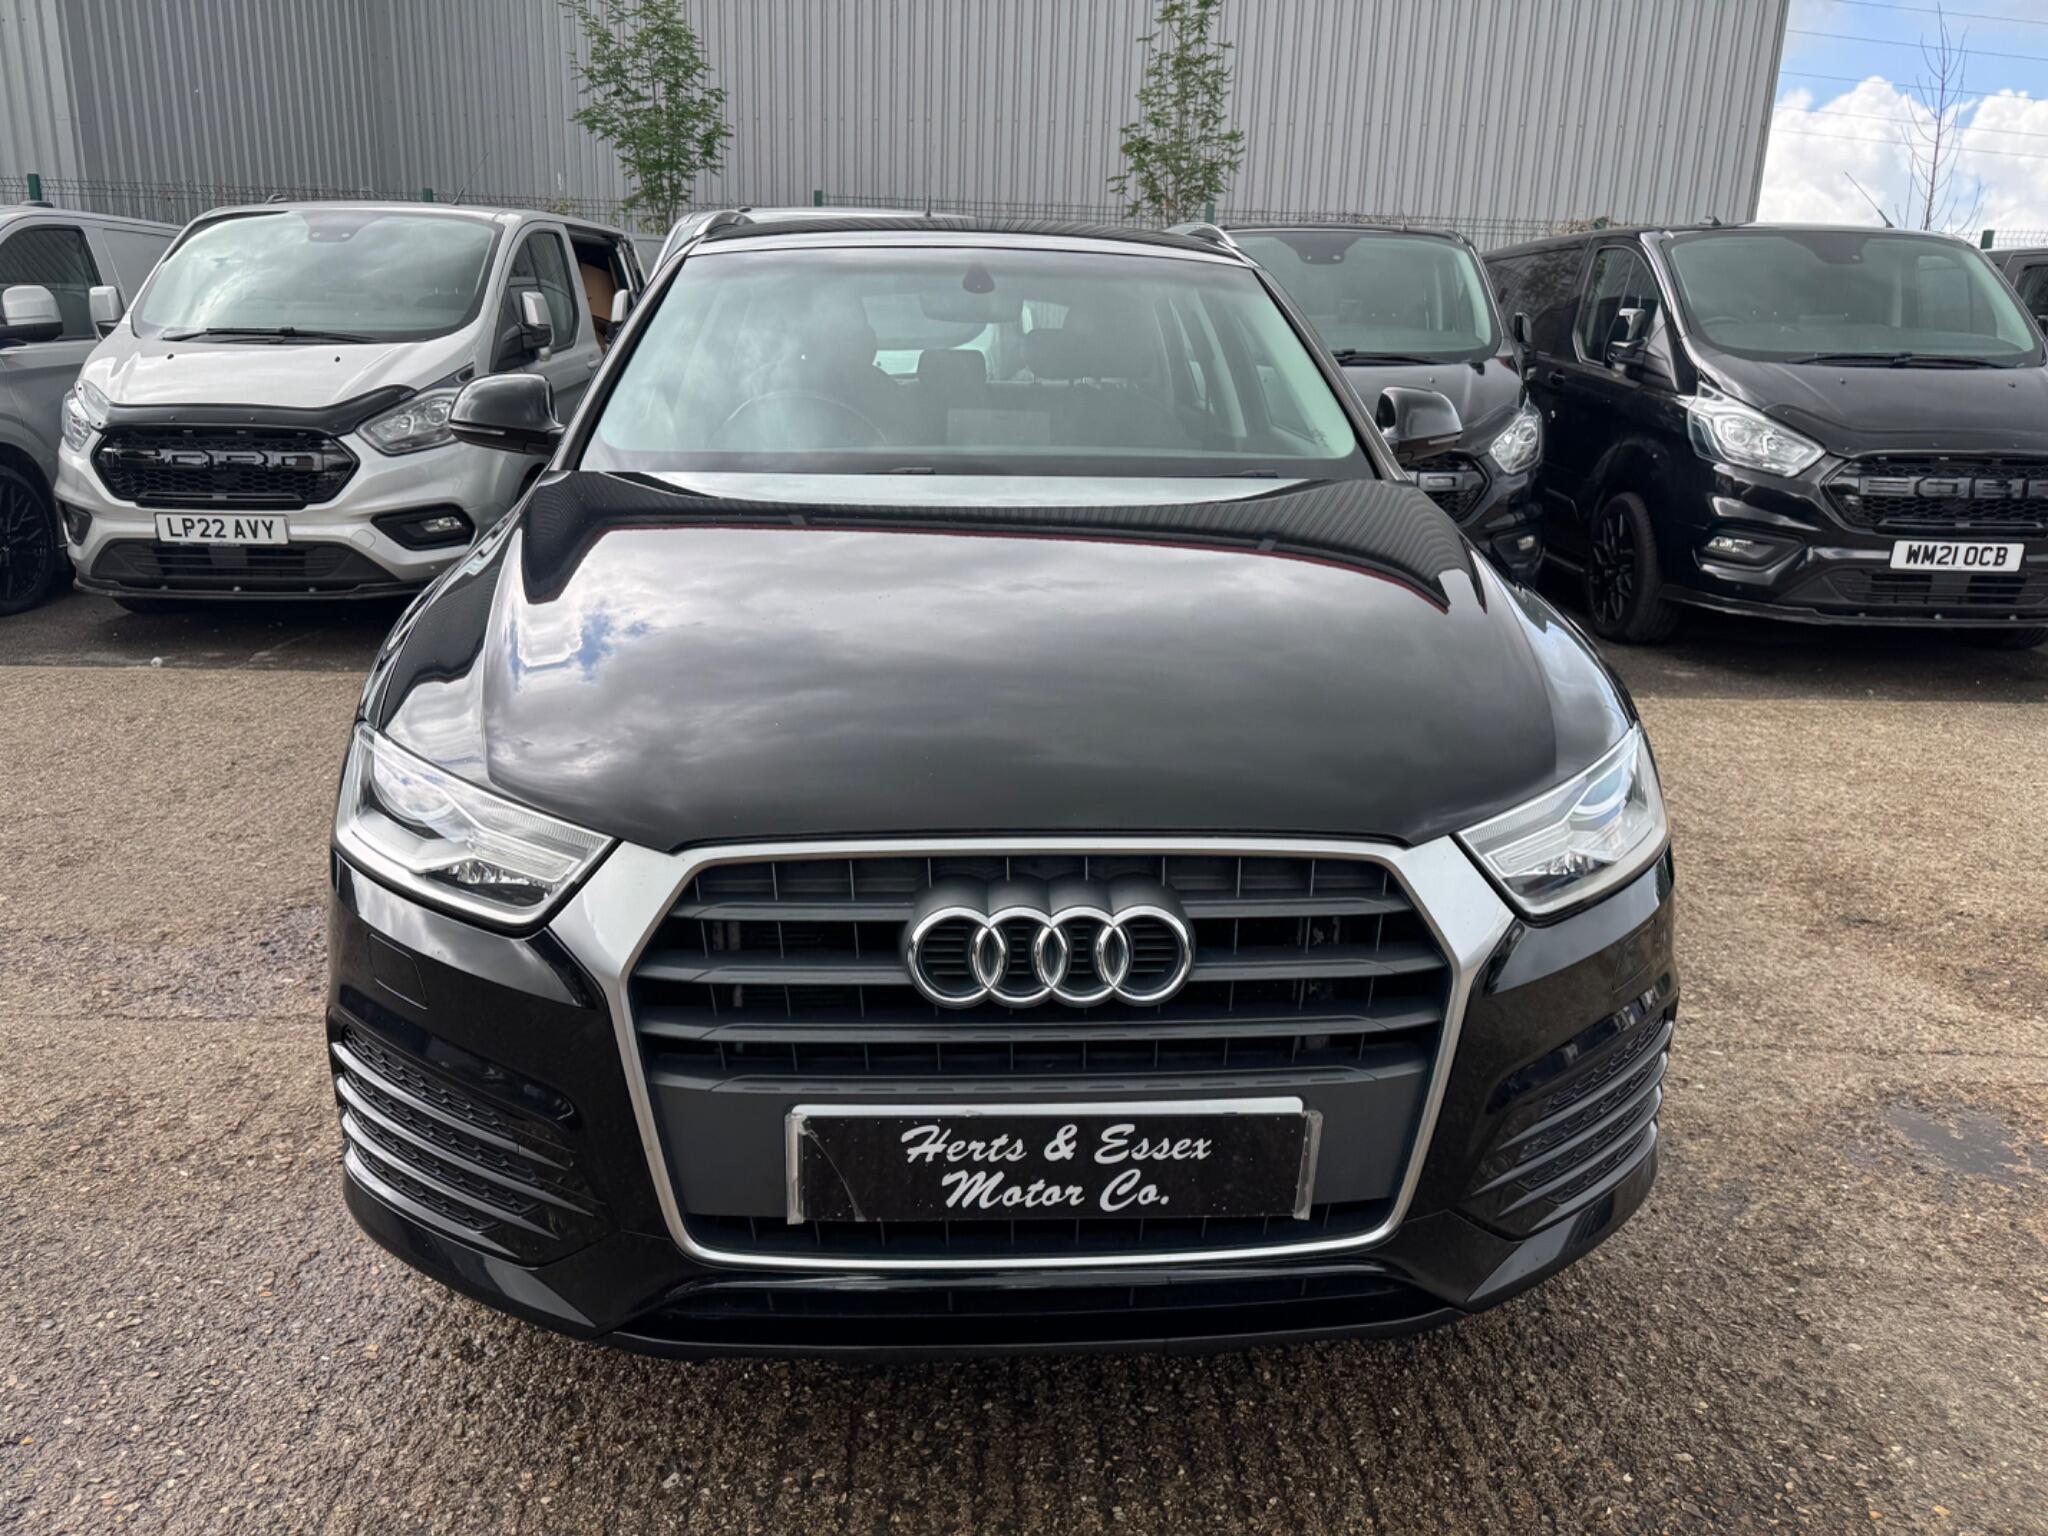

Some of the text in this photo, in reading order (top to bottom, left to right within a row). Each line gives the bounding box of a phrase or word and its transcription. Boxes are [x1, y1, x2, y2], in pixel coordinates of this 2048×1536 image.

[167, 517, 274, 540] LP22 AVY
[1906, 544, 2009, 567] WM21 OCB
[901, 1123, 1212, 1164] Herts & Essex
[941, 1168, 1169, 1212] Motor Co.
